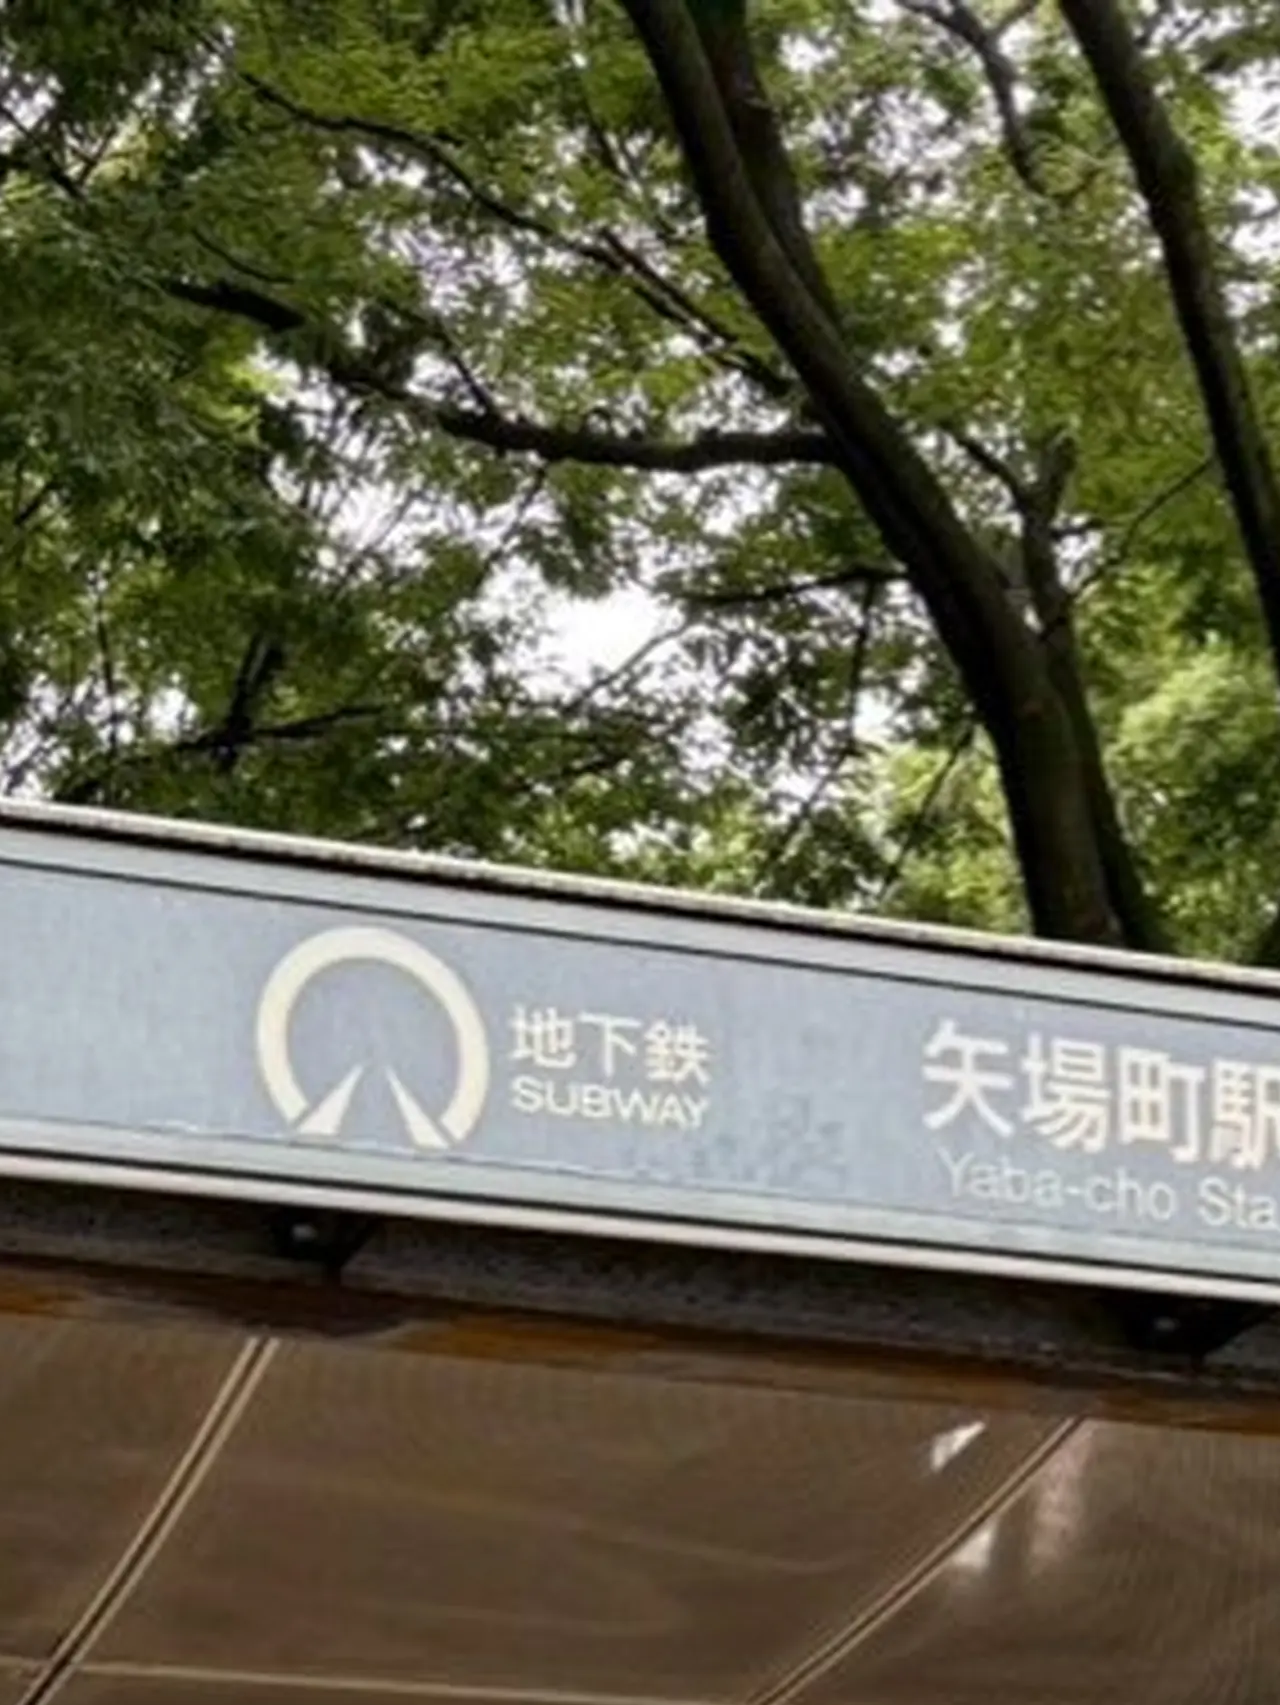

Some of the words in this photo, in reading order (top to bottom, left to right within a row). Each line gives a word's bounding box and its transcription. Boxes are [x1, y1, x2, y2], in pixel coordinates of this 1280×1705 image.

[509, 1004, 712, 1084] 地下鉄
[511, 1075, 710, 1129] SUBWAY
[938, 1146, 1177, 1222] Yaba-cho
